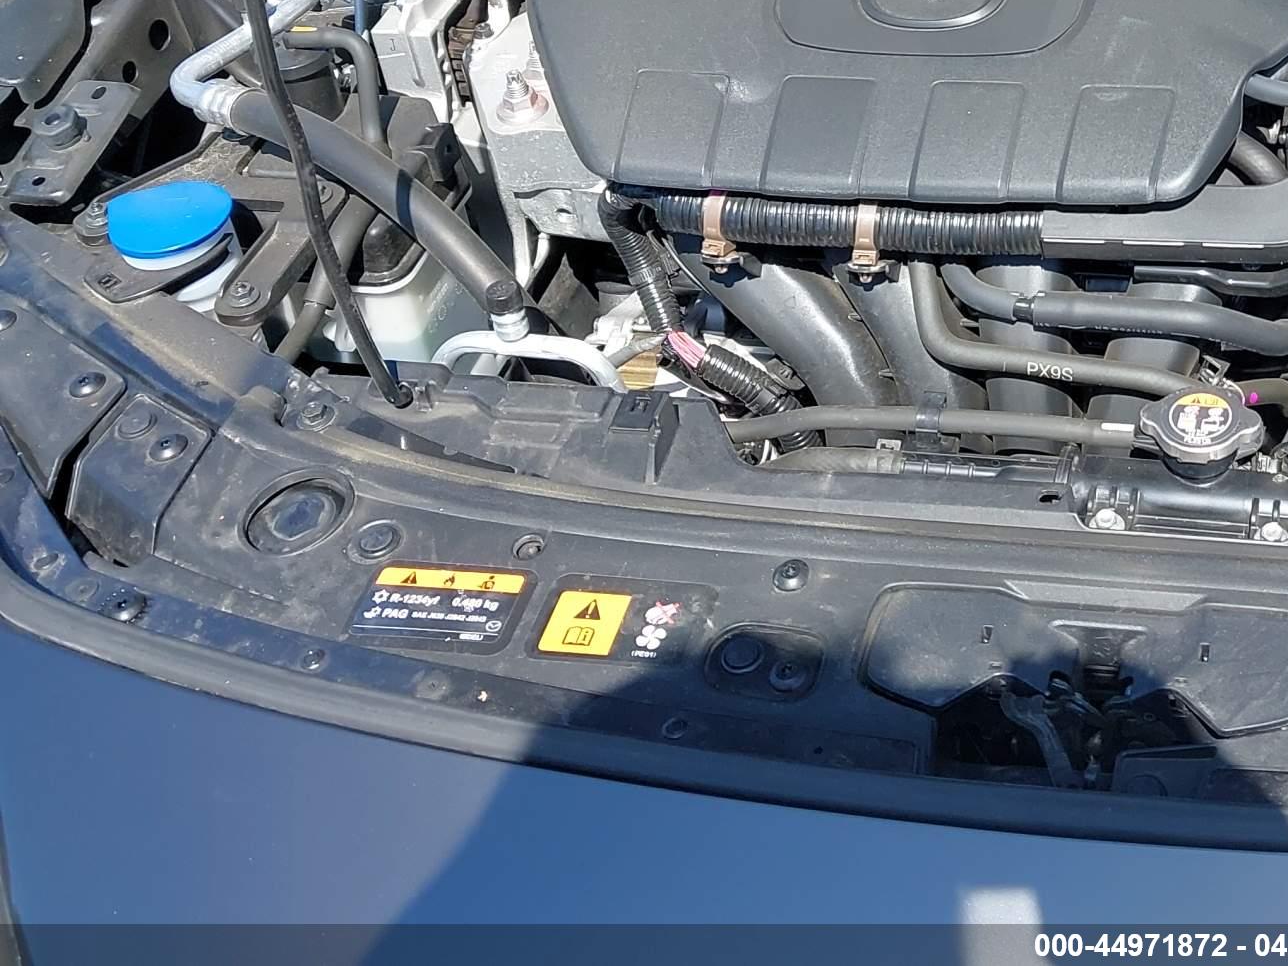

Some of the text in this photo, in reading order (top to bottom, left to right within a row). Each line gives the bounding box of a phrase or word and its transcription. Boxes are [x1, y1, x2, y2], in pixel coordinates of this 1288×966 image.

[1027, 361, 1073, 382] PX9S
[388, 592, 441, 607] R-1234yf
[483, 599, 500, 612] kg
[381, 607, 409, 619] PAG
